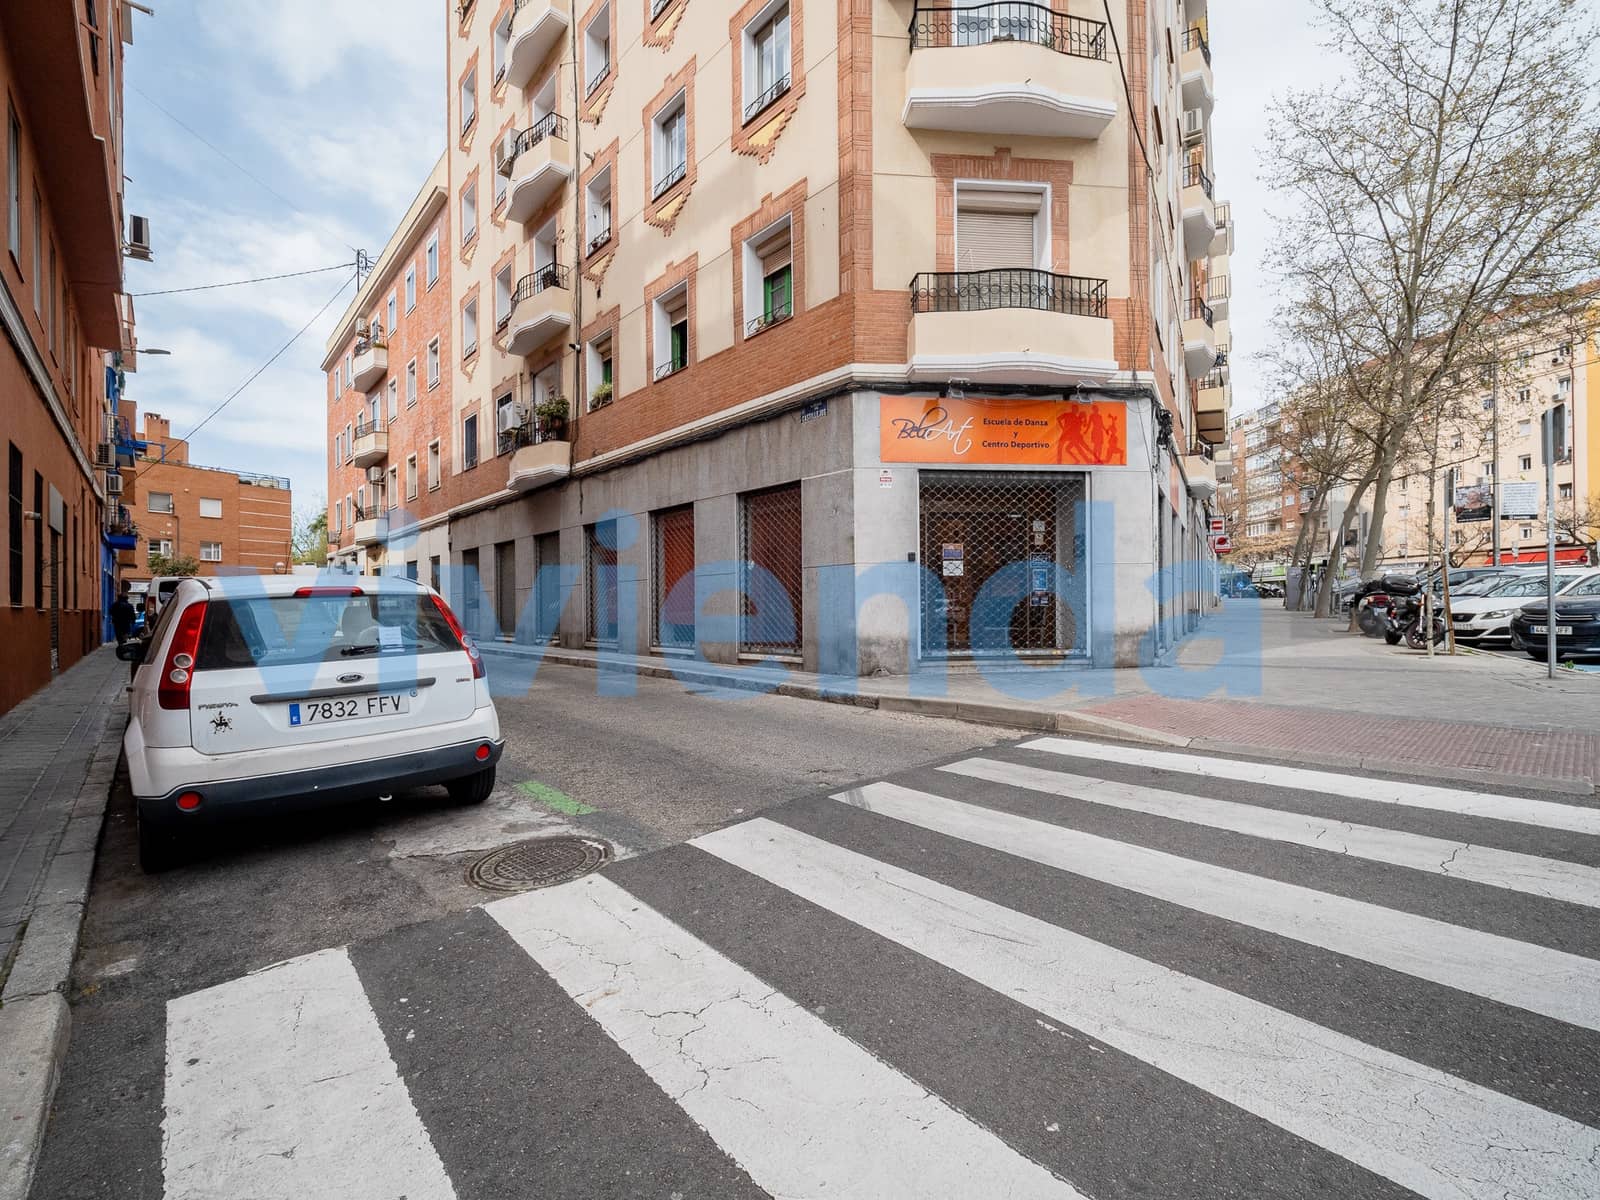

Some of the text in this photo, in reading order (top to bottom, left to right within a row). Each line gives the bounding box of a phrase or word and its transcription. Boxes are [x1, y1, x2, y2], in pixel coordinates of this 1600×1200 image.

[1013, 418, 1023, 426] de
[1025, 418, 1049, 426] Danza
[1013, 431, 1019, 439] y
[982, 440, 1050, 450] Centro Deportivo
[307, 695, 401, 722] 7832 FFV
